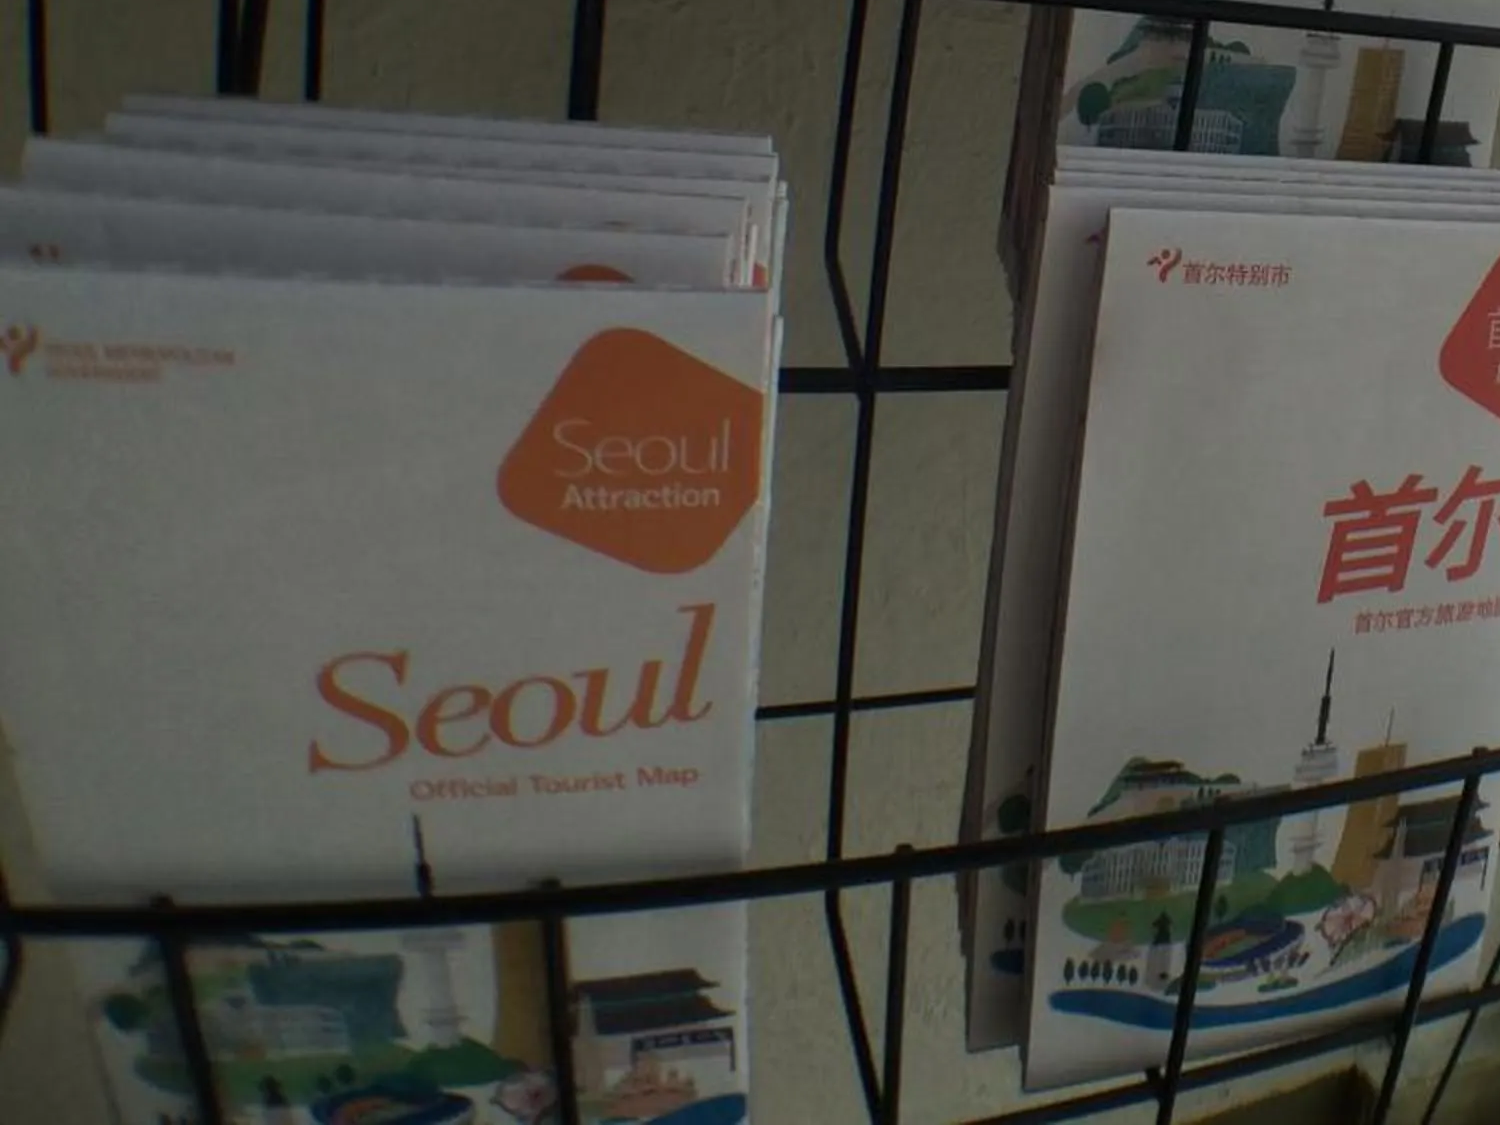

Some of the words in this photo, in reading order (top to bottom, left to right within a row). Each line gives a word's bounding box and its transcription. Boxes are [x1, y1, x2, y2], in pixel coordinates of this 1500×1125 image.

[1182, 262, 1292, 288] 首尔特别市
[552, 417, 731, 479] Seoul
[560, 482, 721, 513] Attraction
[308, 601, 716, 776] Seoul
[408, 776, 520, 804] Official
[529, 770, 626, 796] Tourist
[637, 763, 700, 792] Map
